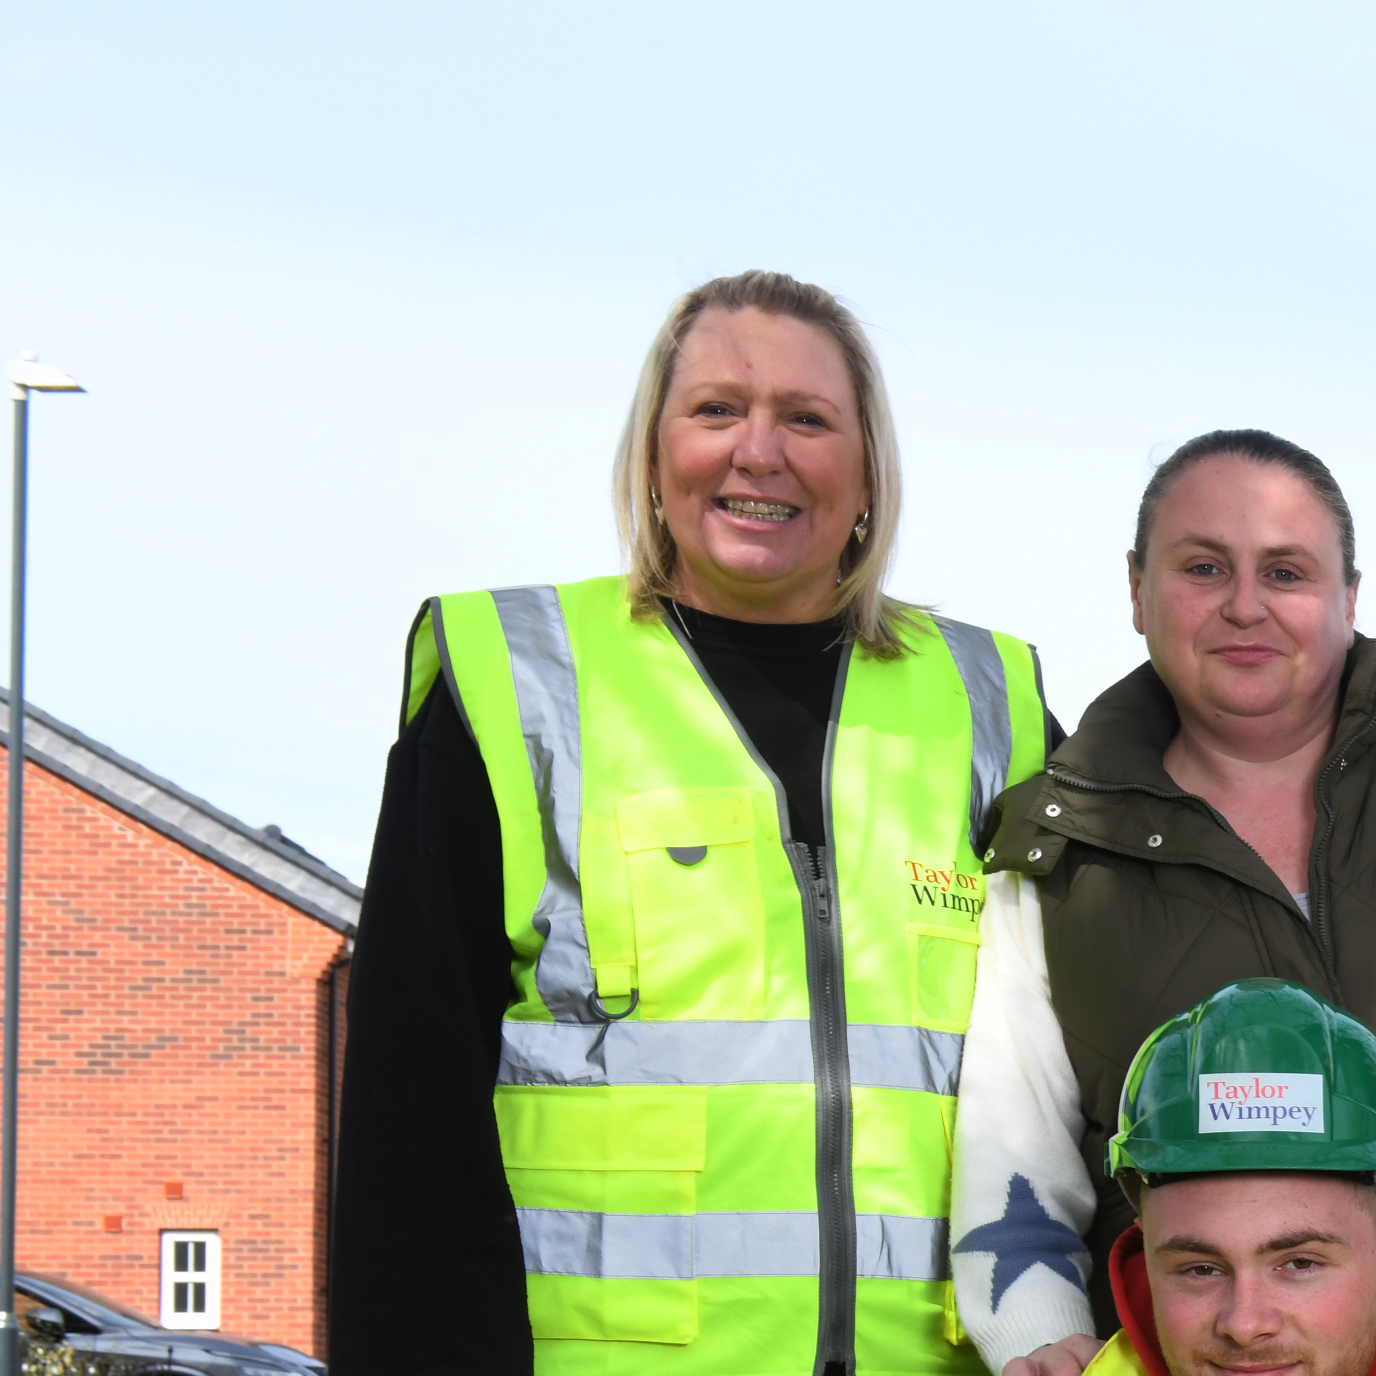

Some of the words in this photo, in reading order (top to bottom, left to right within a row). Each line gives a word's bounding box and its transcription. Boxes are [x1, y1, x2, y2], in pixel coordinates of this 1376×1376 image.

[909, 883, 981, 922] Wimp
[1206, 1077, 1289, 1105] Taylor
[1207, 1102, 1317, 1126] Wimpey
